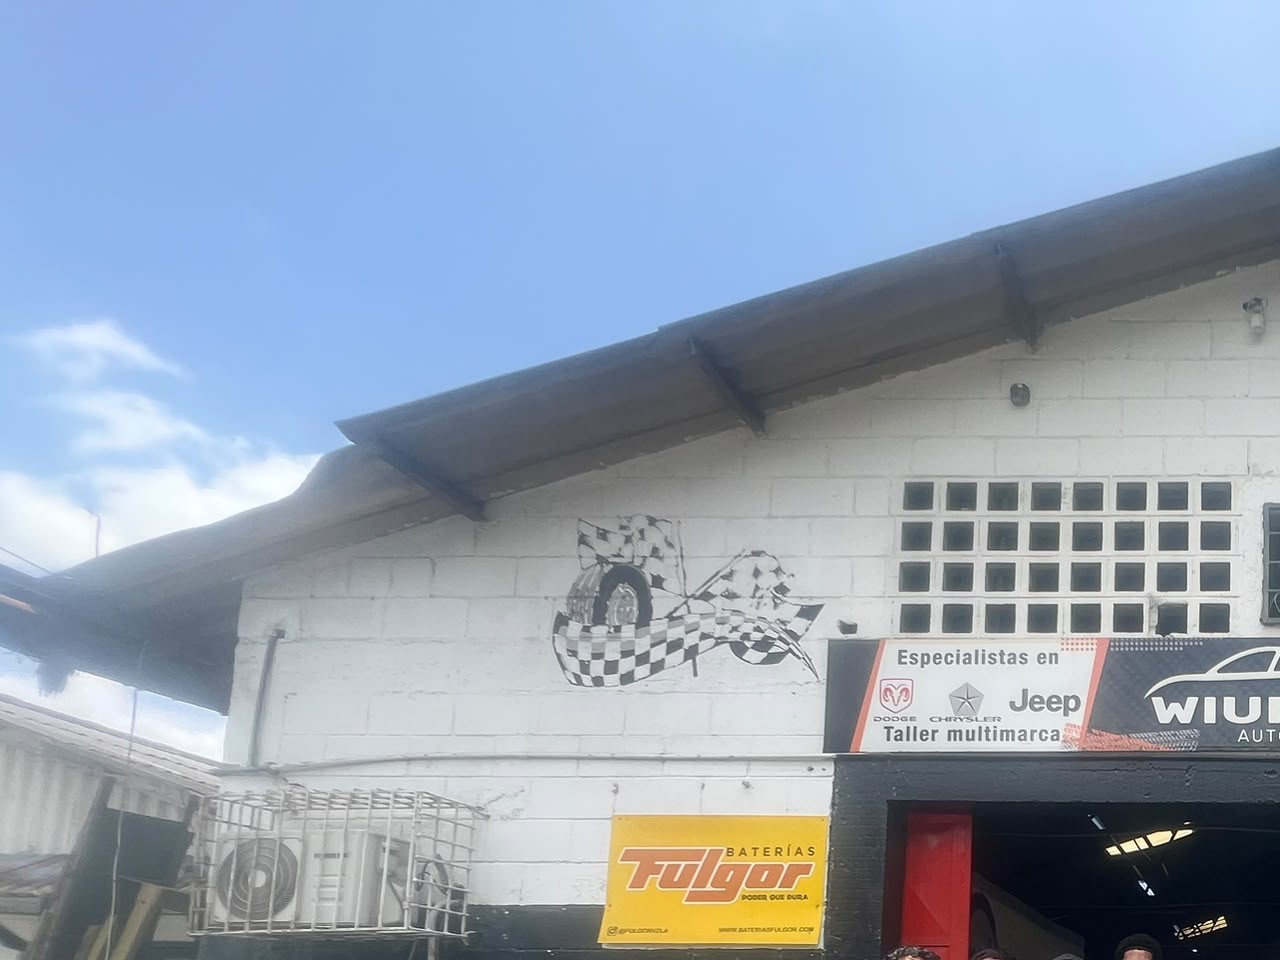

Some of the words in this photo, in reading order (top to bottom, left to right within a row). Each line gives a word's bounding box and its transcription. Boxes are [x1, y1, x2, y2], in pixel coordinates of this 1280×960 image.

[898, 650, 1028, 668] Especialistas
[1036, 652, 1059, 665] en
[1009, 688, 1081, 717] Jeep
[884, 726, 939, 742] Taller
[947, 726, 1061, 742] multimarca
[726, 844, 816, 857] BATERÍAS
[618, 846, 816, 904] Fulgor
